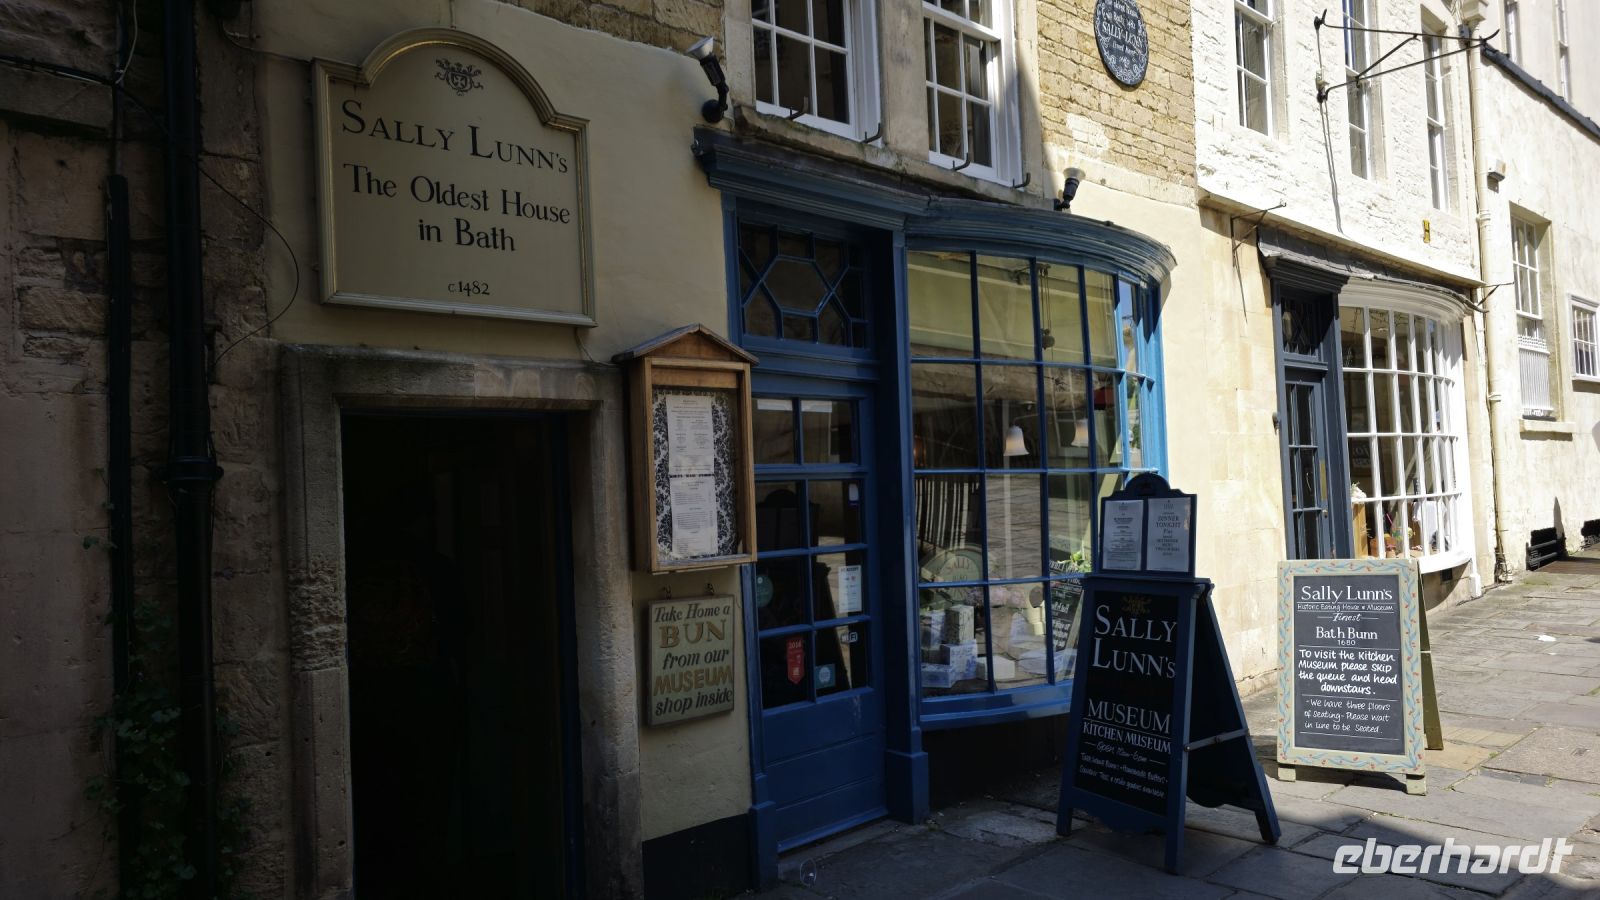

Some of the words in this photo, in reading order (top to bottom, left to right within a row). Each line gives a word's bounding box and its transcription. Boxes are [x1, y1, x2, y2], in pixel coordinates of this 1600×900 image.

[342, 99, 454, 151] SALLY
[467, 124, 568, 173] LUNN'S
[343, 163, 397, 198] The
[410, 175, 489, 211] Oldest
[501, 189, 571, 224] House
[418, 219, 442, 242] in
[455, 218, 515, 251] Bath
[1301, 585, 1343, 604] Sally
[1346, 585, 1393, 600] Lunn's
[654, 606, 683, 623] Take
[686, 603, 720, 620] Home
[723, 604, 731, 616] a
[1332, 612, 1362, 622] Finest
[1342, 603, 1360, 611] House
[659, 619, 727, 648] BUN
[1094, 604, 1178, 643] SALLY
[1315, 626, 1345, 639] Bath
[1347, 626, 1378, 640] Bunn
[663, 652, 699, 670] from
[704, 649, 730, 664] our
[1092, 638, 1176, 679] LUNN'S
[1299, 649, 1312, 658] To
[1314, 649, 1337, 659] visit
[1339, 650, 1355, 660] the
[1298, 660, 1338, 669] Museum
[1341, 662, 1368, 671] please
[653, 665, 733, 697] MUSEUM
[1298, 670, 1315, 680] the
[1316, 672, 1347, 683] queue
[1351, 674, 1371, 682] and
[1373, 674, 1398, 684] head
[655, 695, 693, 717] shop
[695, 688, 733, 709] inside
[1323, 699, 1343, 708] have
[1346, 700, 1366, 709] three
[1367, 701, 1391, 712] floors
[1087, 698, 1172, 734] MUSEUM
[1304, 710, 1312, 719] of
[1371, 714, 1391, 722] wait
[1304, 721, 1313, 729] in
[1315, 722, 1330, 730] line
[1333, 722, 1340, 730] to
[1342, 722, 1351, 731] be
[1083, 722, 1123, 743] KITCHEN
[1124, 732, 1172, 755] MUSEUM
